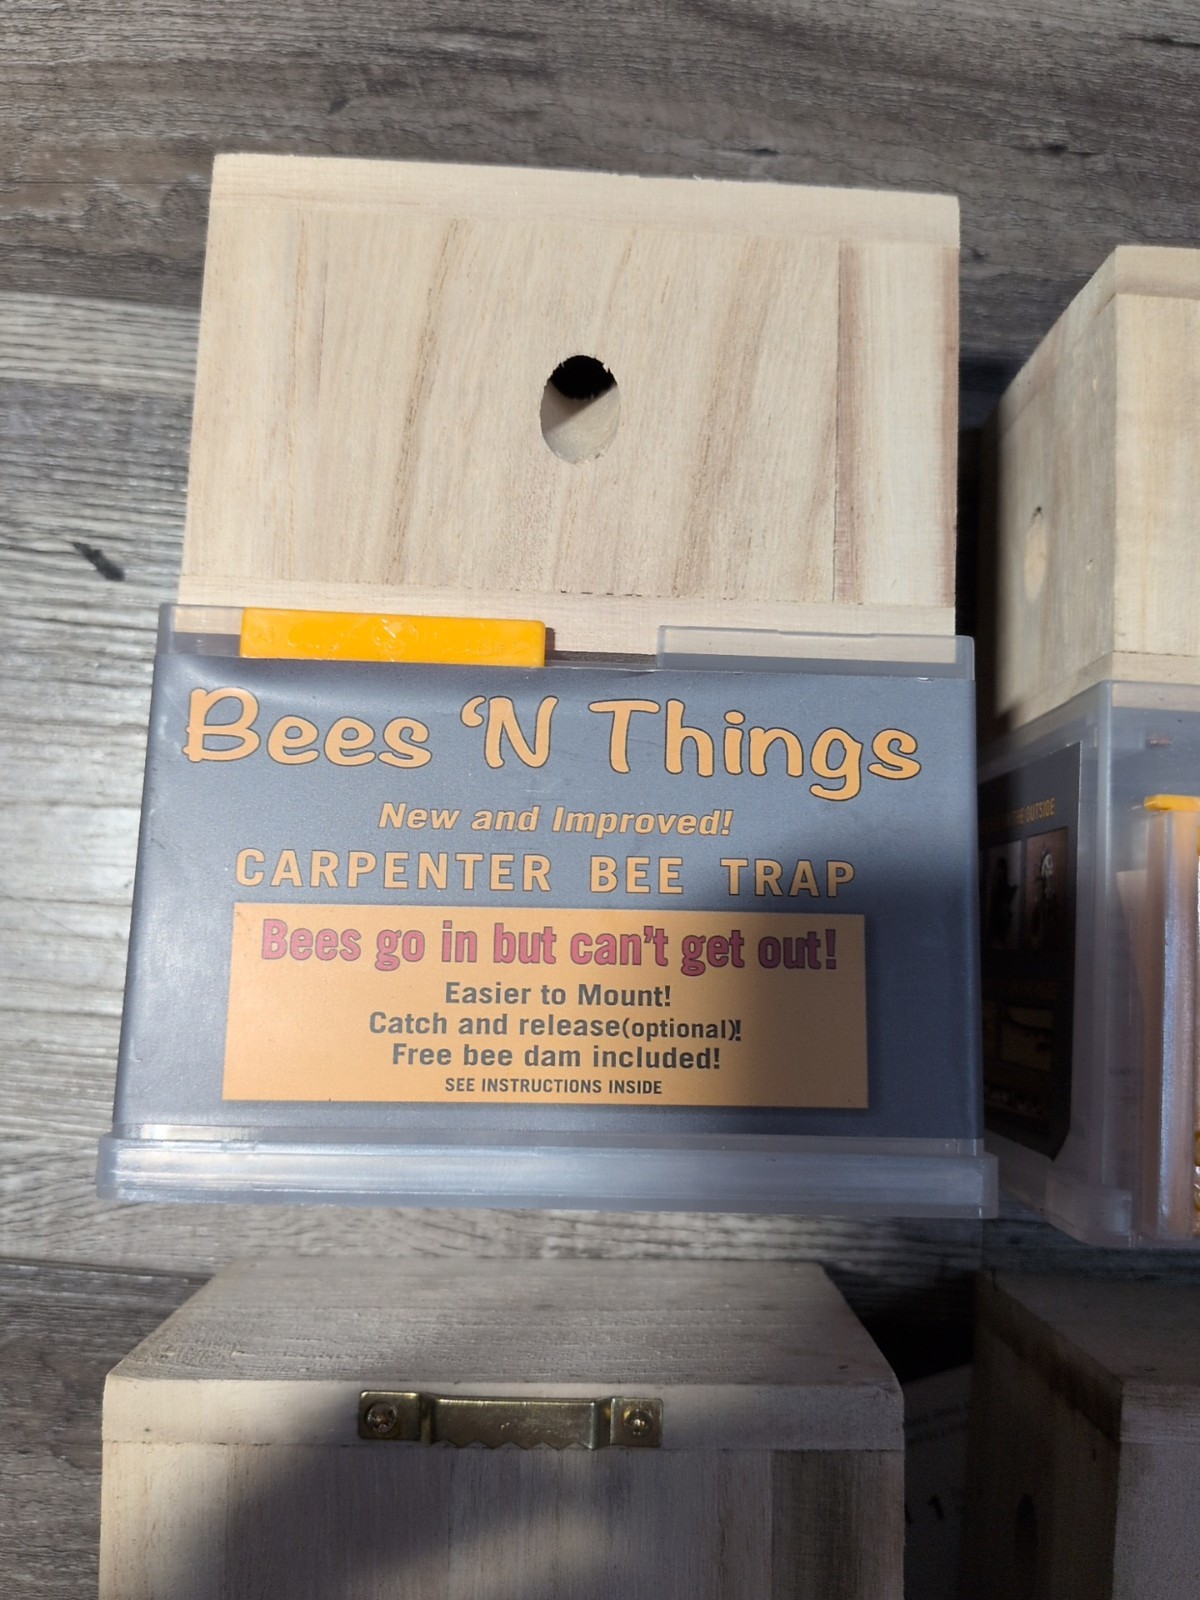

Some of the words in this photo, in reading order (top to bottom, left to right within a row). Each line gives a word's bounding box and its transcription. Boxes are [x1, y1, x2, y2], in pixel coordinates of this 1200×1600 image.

[182, 686, 432, 769] Bees
[588, 698, 921, 801] Things
[378, 802, 460, 830] New
[471, 806, 541, 832] and
[552, 805, 734, 839] Improved!
[1026, 797, 1056, 822] OUTSIDE
[235, 848, 552, 893] CARPENTER
[589, 855, 684, 894] BEE
[720, 858, 856, 898] TRAP
[261, 918, 362, 961] Bees
[374, 929, 425, 971] go
[441, 920, 477, 963] in
[493, 922, 557, 964] but
[570, 925, 668, 966] can't
[681, 930, 745, 976] get
[758, 929, 837, 969] out!
[445, 981, 531, 1005] Easier
[541, 985, 566, 1005] to
[578, 984, 671, 1007] Mount!
[369, 1011, 447, 1034] Catch
[458, 1014, 507, 1035] and
[392, 1043, 452, 1066] Free
[463, 1044, 513, 1066] bee
[524, 1045, 580, 1067] dam
[593, 1045, 720, 1070] included!
[445, 1078, 475, 1092] SEE
[481, 1078, 602, 1093] INSTRUCTIONS
[609, 1080, 662, 1094] INSIDE
